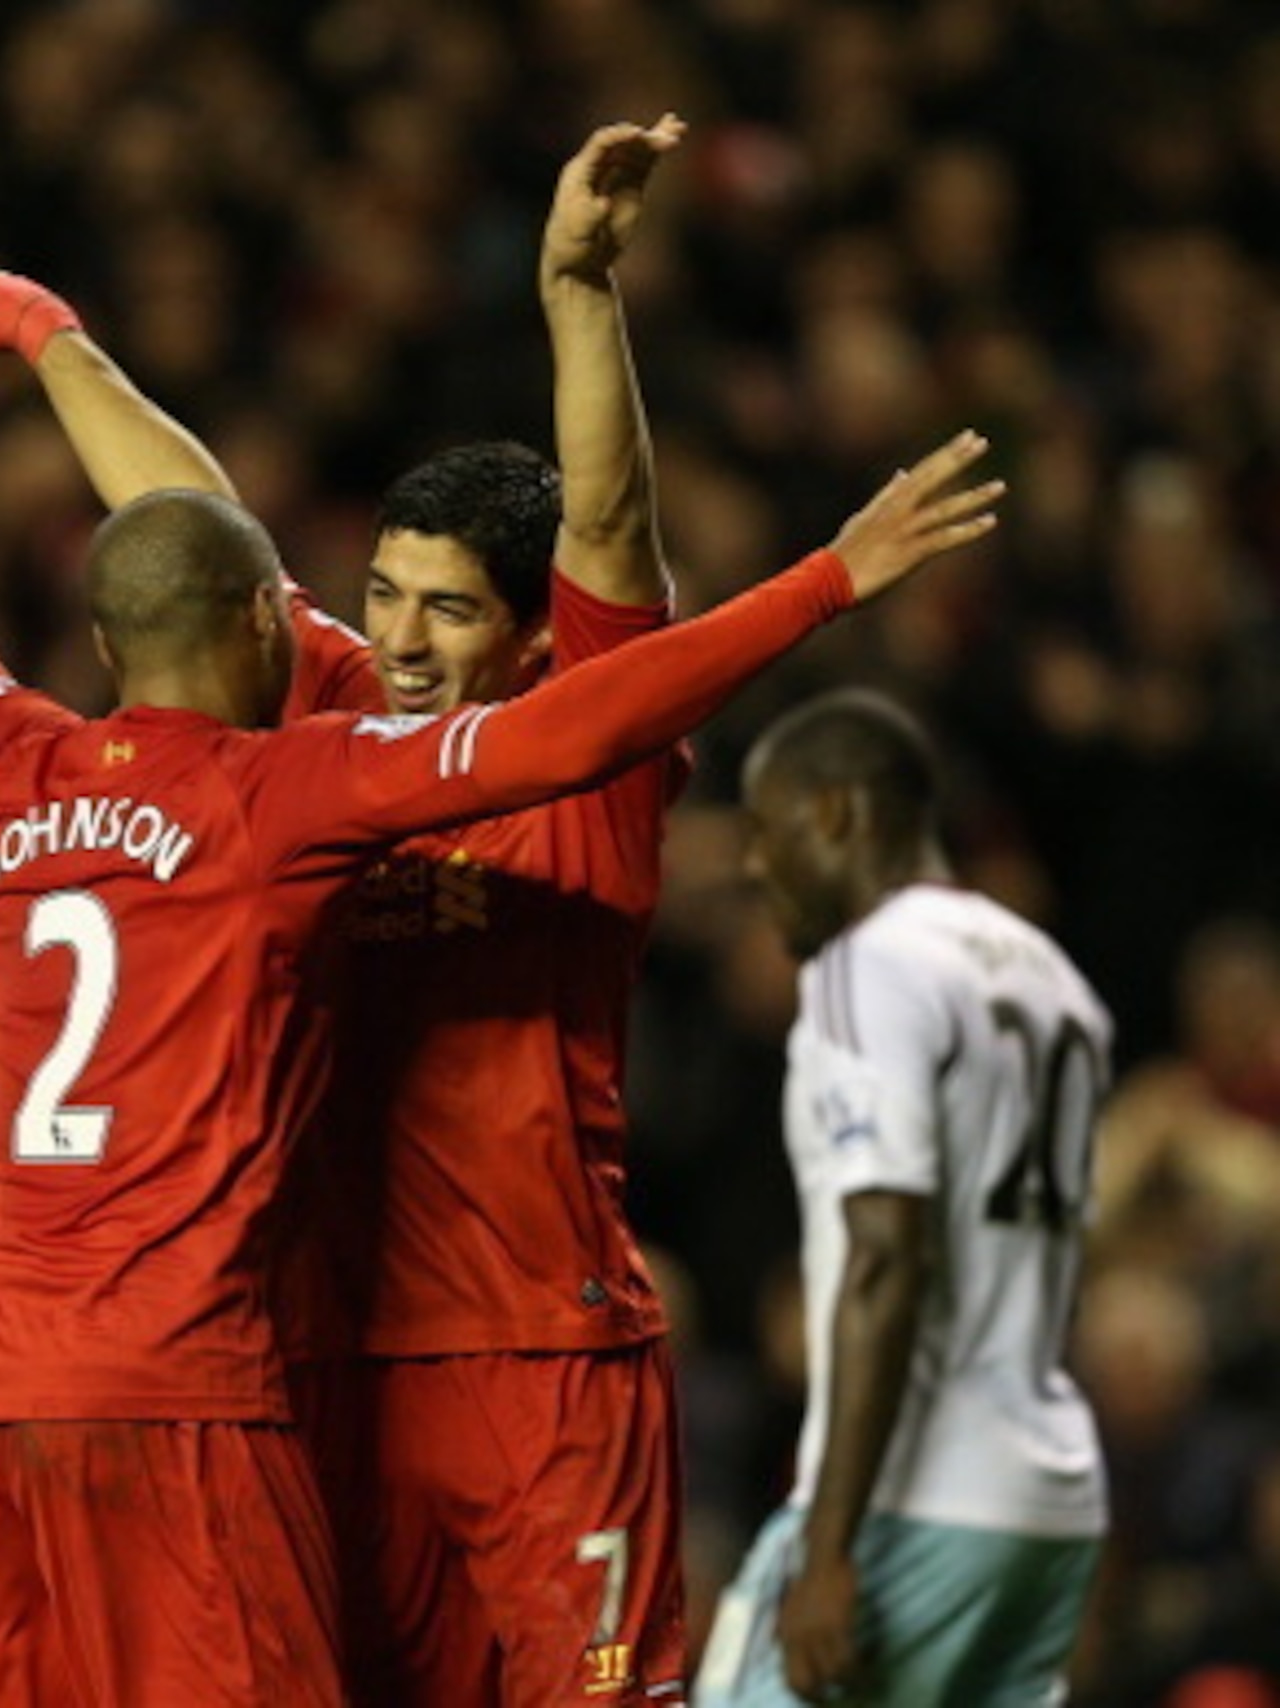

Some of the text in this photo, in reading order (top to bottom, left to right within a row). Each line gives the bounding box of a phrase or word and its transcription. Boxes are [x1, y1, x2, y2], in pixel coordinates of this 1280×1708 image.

[11, 887, 120, 1166] 2
[987, 997, 1111, 1234] 20
[575, 1526, 629, 1644] 7
